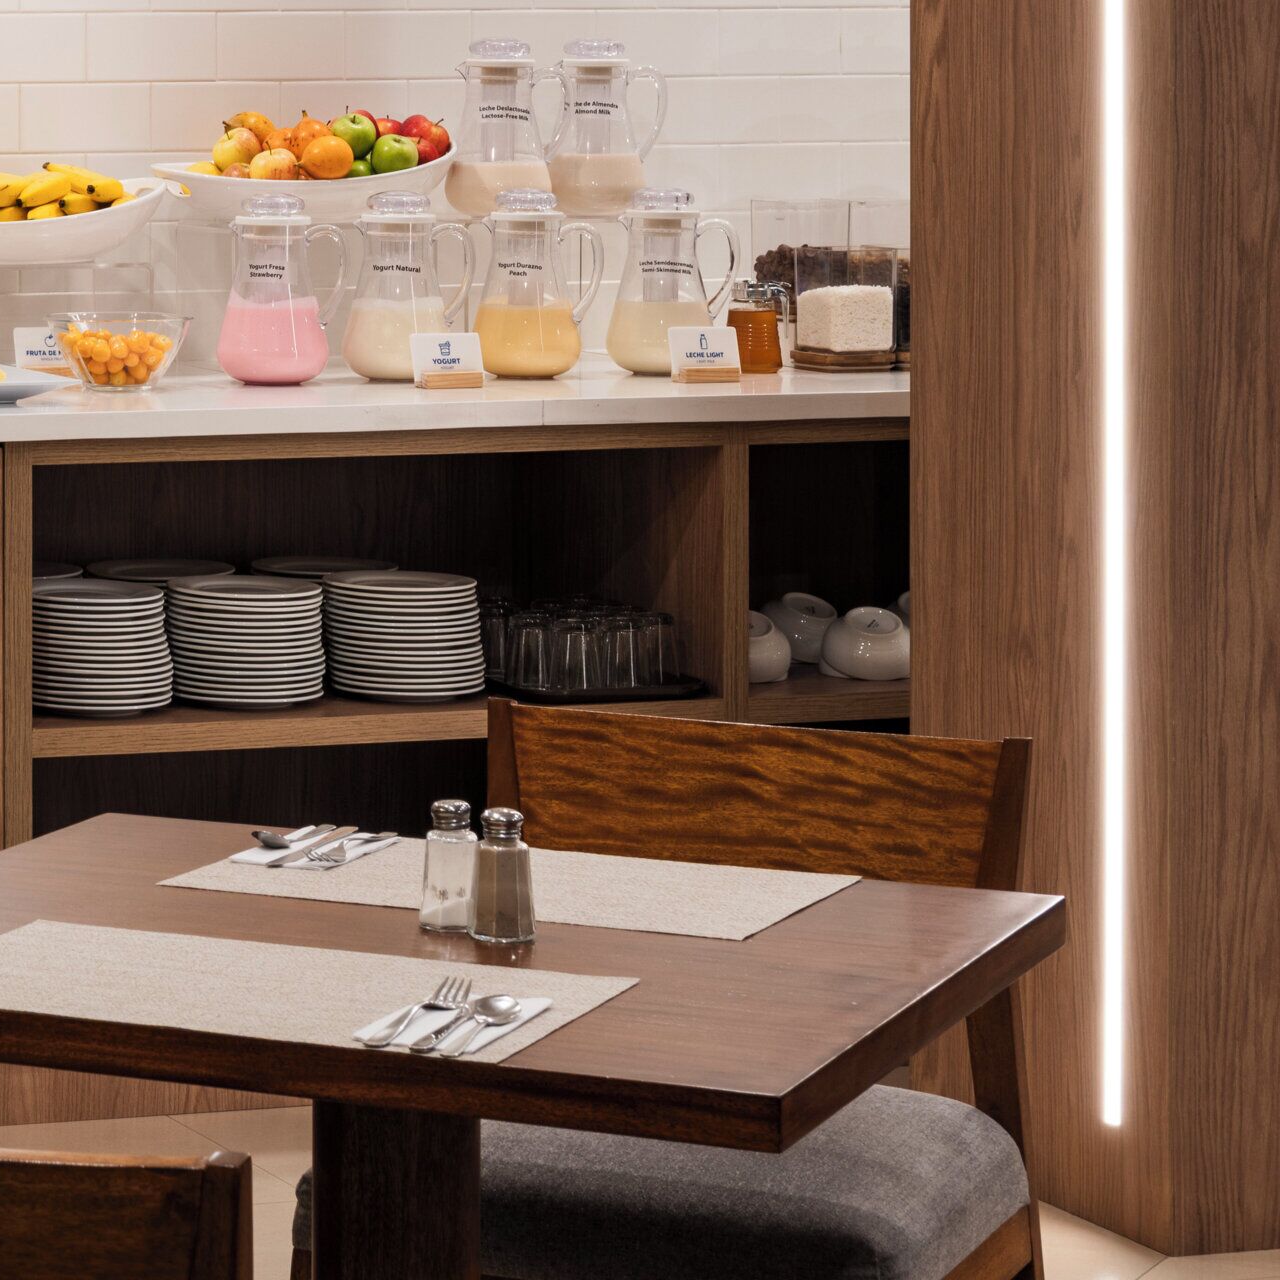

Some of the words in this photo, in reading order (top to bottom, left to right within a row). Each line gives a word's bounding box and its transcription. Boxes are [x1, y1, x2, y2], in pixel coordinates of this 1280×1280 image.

[248, 263, 268, 271] Yogurt
[372, 264, 394, 272] Yogurt
[395, 264, 421, 273] Natural
[516, 262, 543, 270] Durazno
[249, 271, 283, 280] Strawberry
